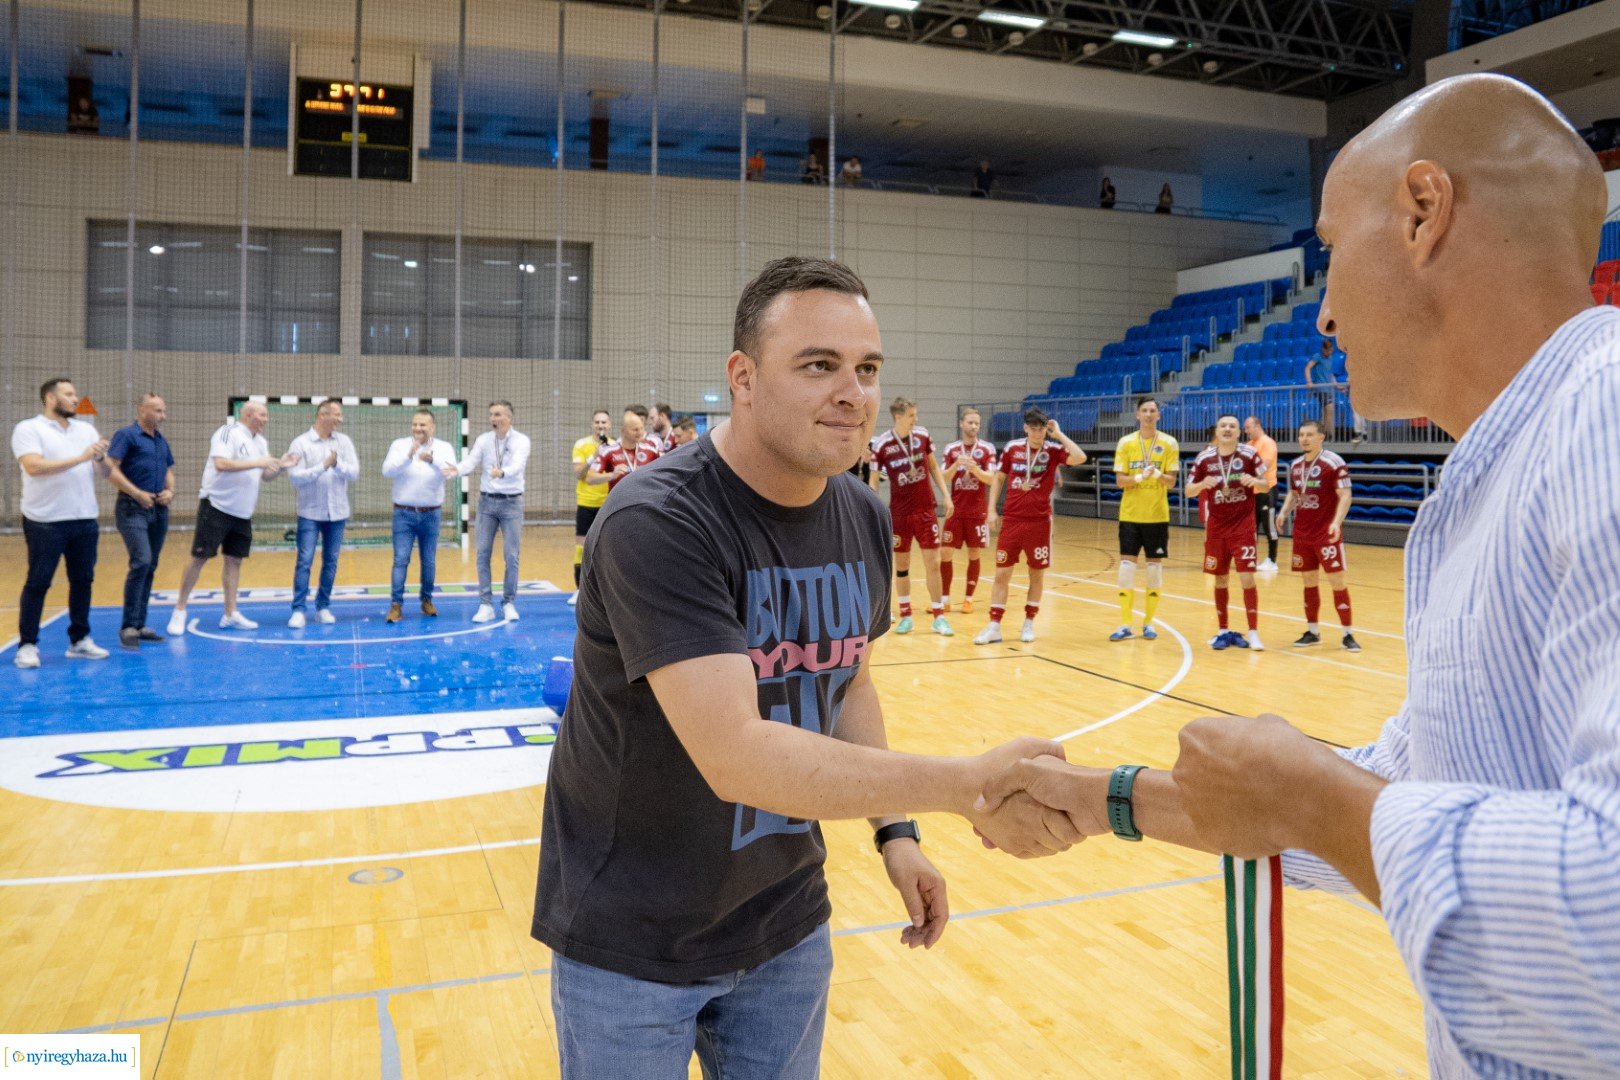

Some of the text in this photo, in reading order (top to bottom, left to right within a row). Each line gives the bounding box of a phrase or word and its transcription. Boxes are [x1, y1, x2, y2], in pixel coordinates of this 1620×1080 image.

[975, 525, 986, 537] 19
[1034, 546, 1049, 560] 88
[1241, 546, 1256, 560] 22
[1321, 545, 1337, 560] 99
[747, 561, 871, 648] BUTTON
[748, 636, 869, 679] YOUR
